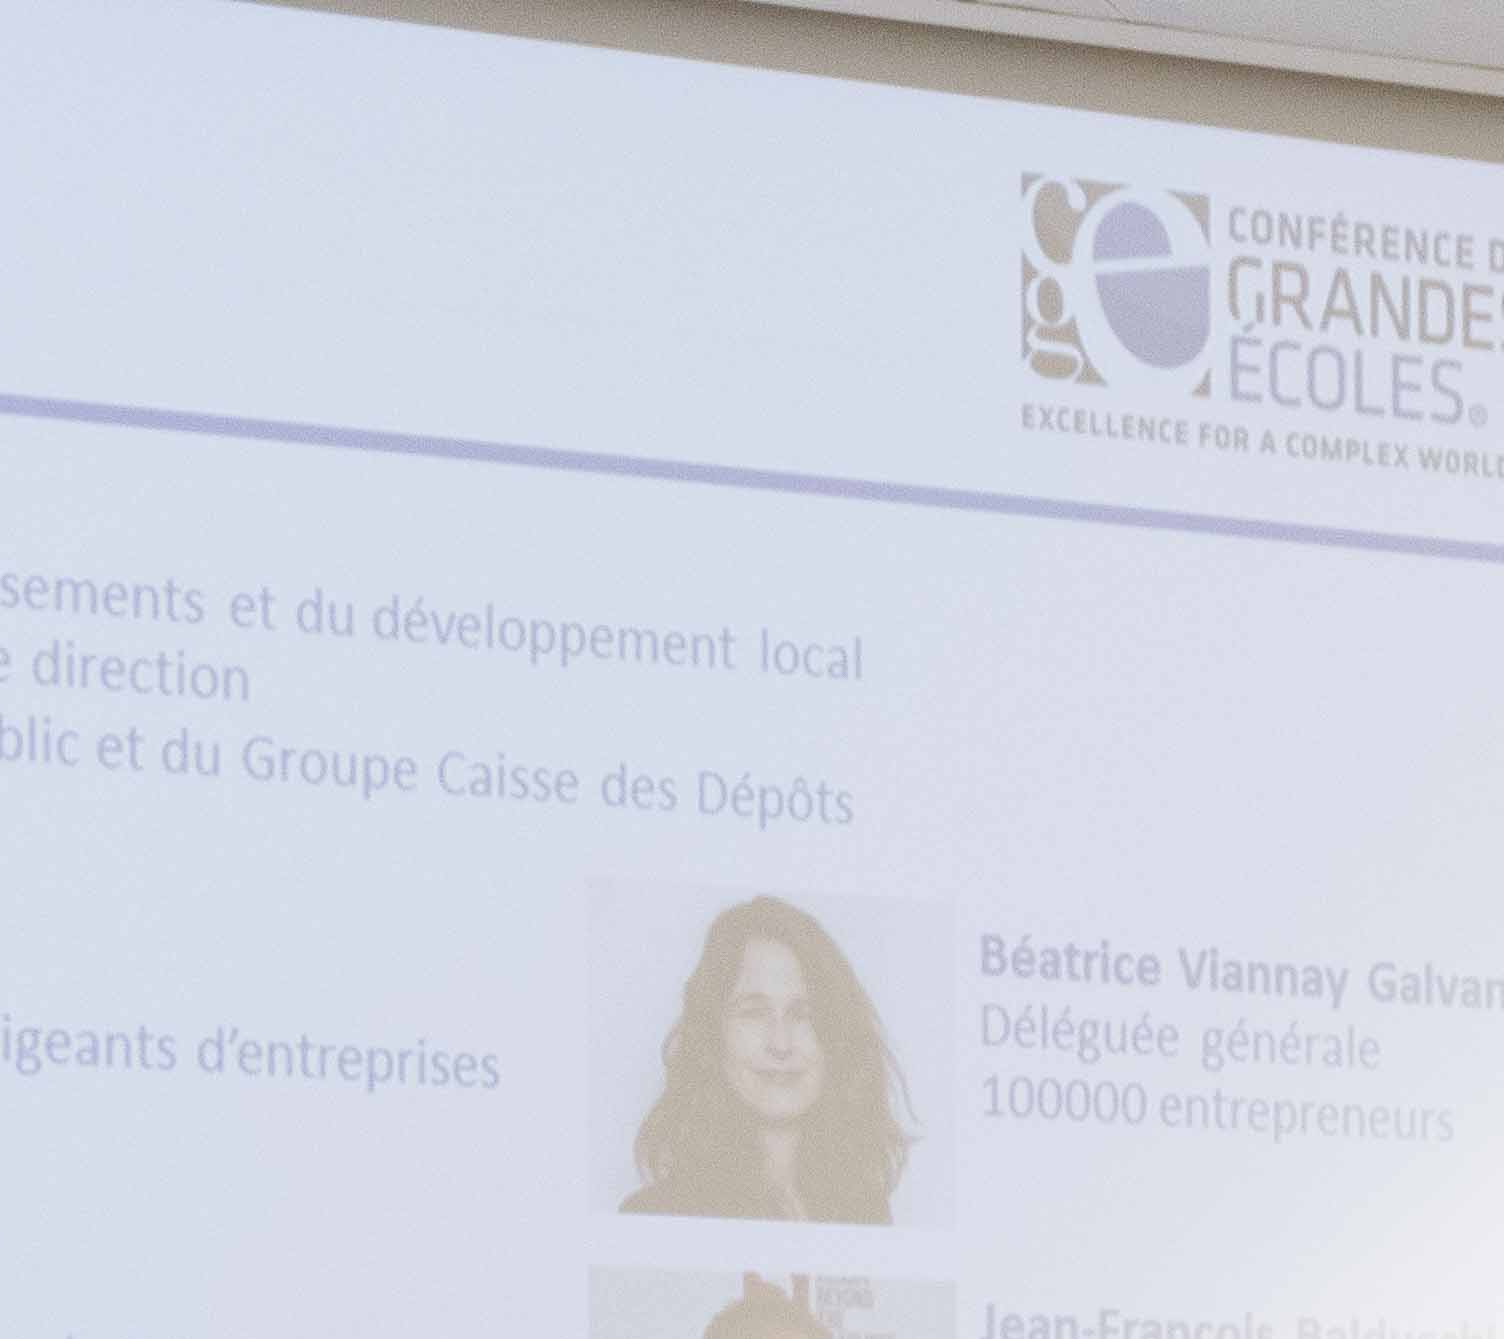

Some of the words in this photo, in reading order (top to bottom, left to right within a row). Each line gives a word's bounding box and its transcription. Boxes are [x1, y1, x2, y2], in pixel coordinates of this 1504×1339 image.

[1228, 206, 1474, 271] CONFÉRENCE
[1021, 403, 1188, 446] EXCELLENCE
[1198, 422, 1249, 452] FOR
[1259, 430, 1276, 454] A
[1285, 432, 1408, 468] COMPLEX
[229, 587, 275, 631] et
[296, 588, 354, 637] du
[372, 594, 735, 670] développement
[760, 628, 862, 680] local
[32, 639, 249, 702] direction
[96, 727, 143, 772] et
[161, 727, 220, 777] du
[241, 736, 418, 800] Groupe
[437, 751, 579, 804] Caisse
[600, 762, 677, 812] des
[698, 770, 854, 831] Dépôts
[980, 933, 1161, 987] Béatrice
[1178, 947, 1349, 1010] Viannay
[981, 1003, 1179, 1065] Déléguée
[1201, 1017, 1380, 1073] générale
[983, 1074, 1148, 1125] 100000
[1158, 1088, 1453, 1144] entrepreneurs
